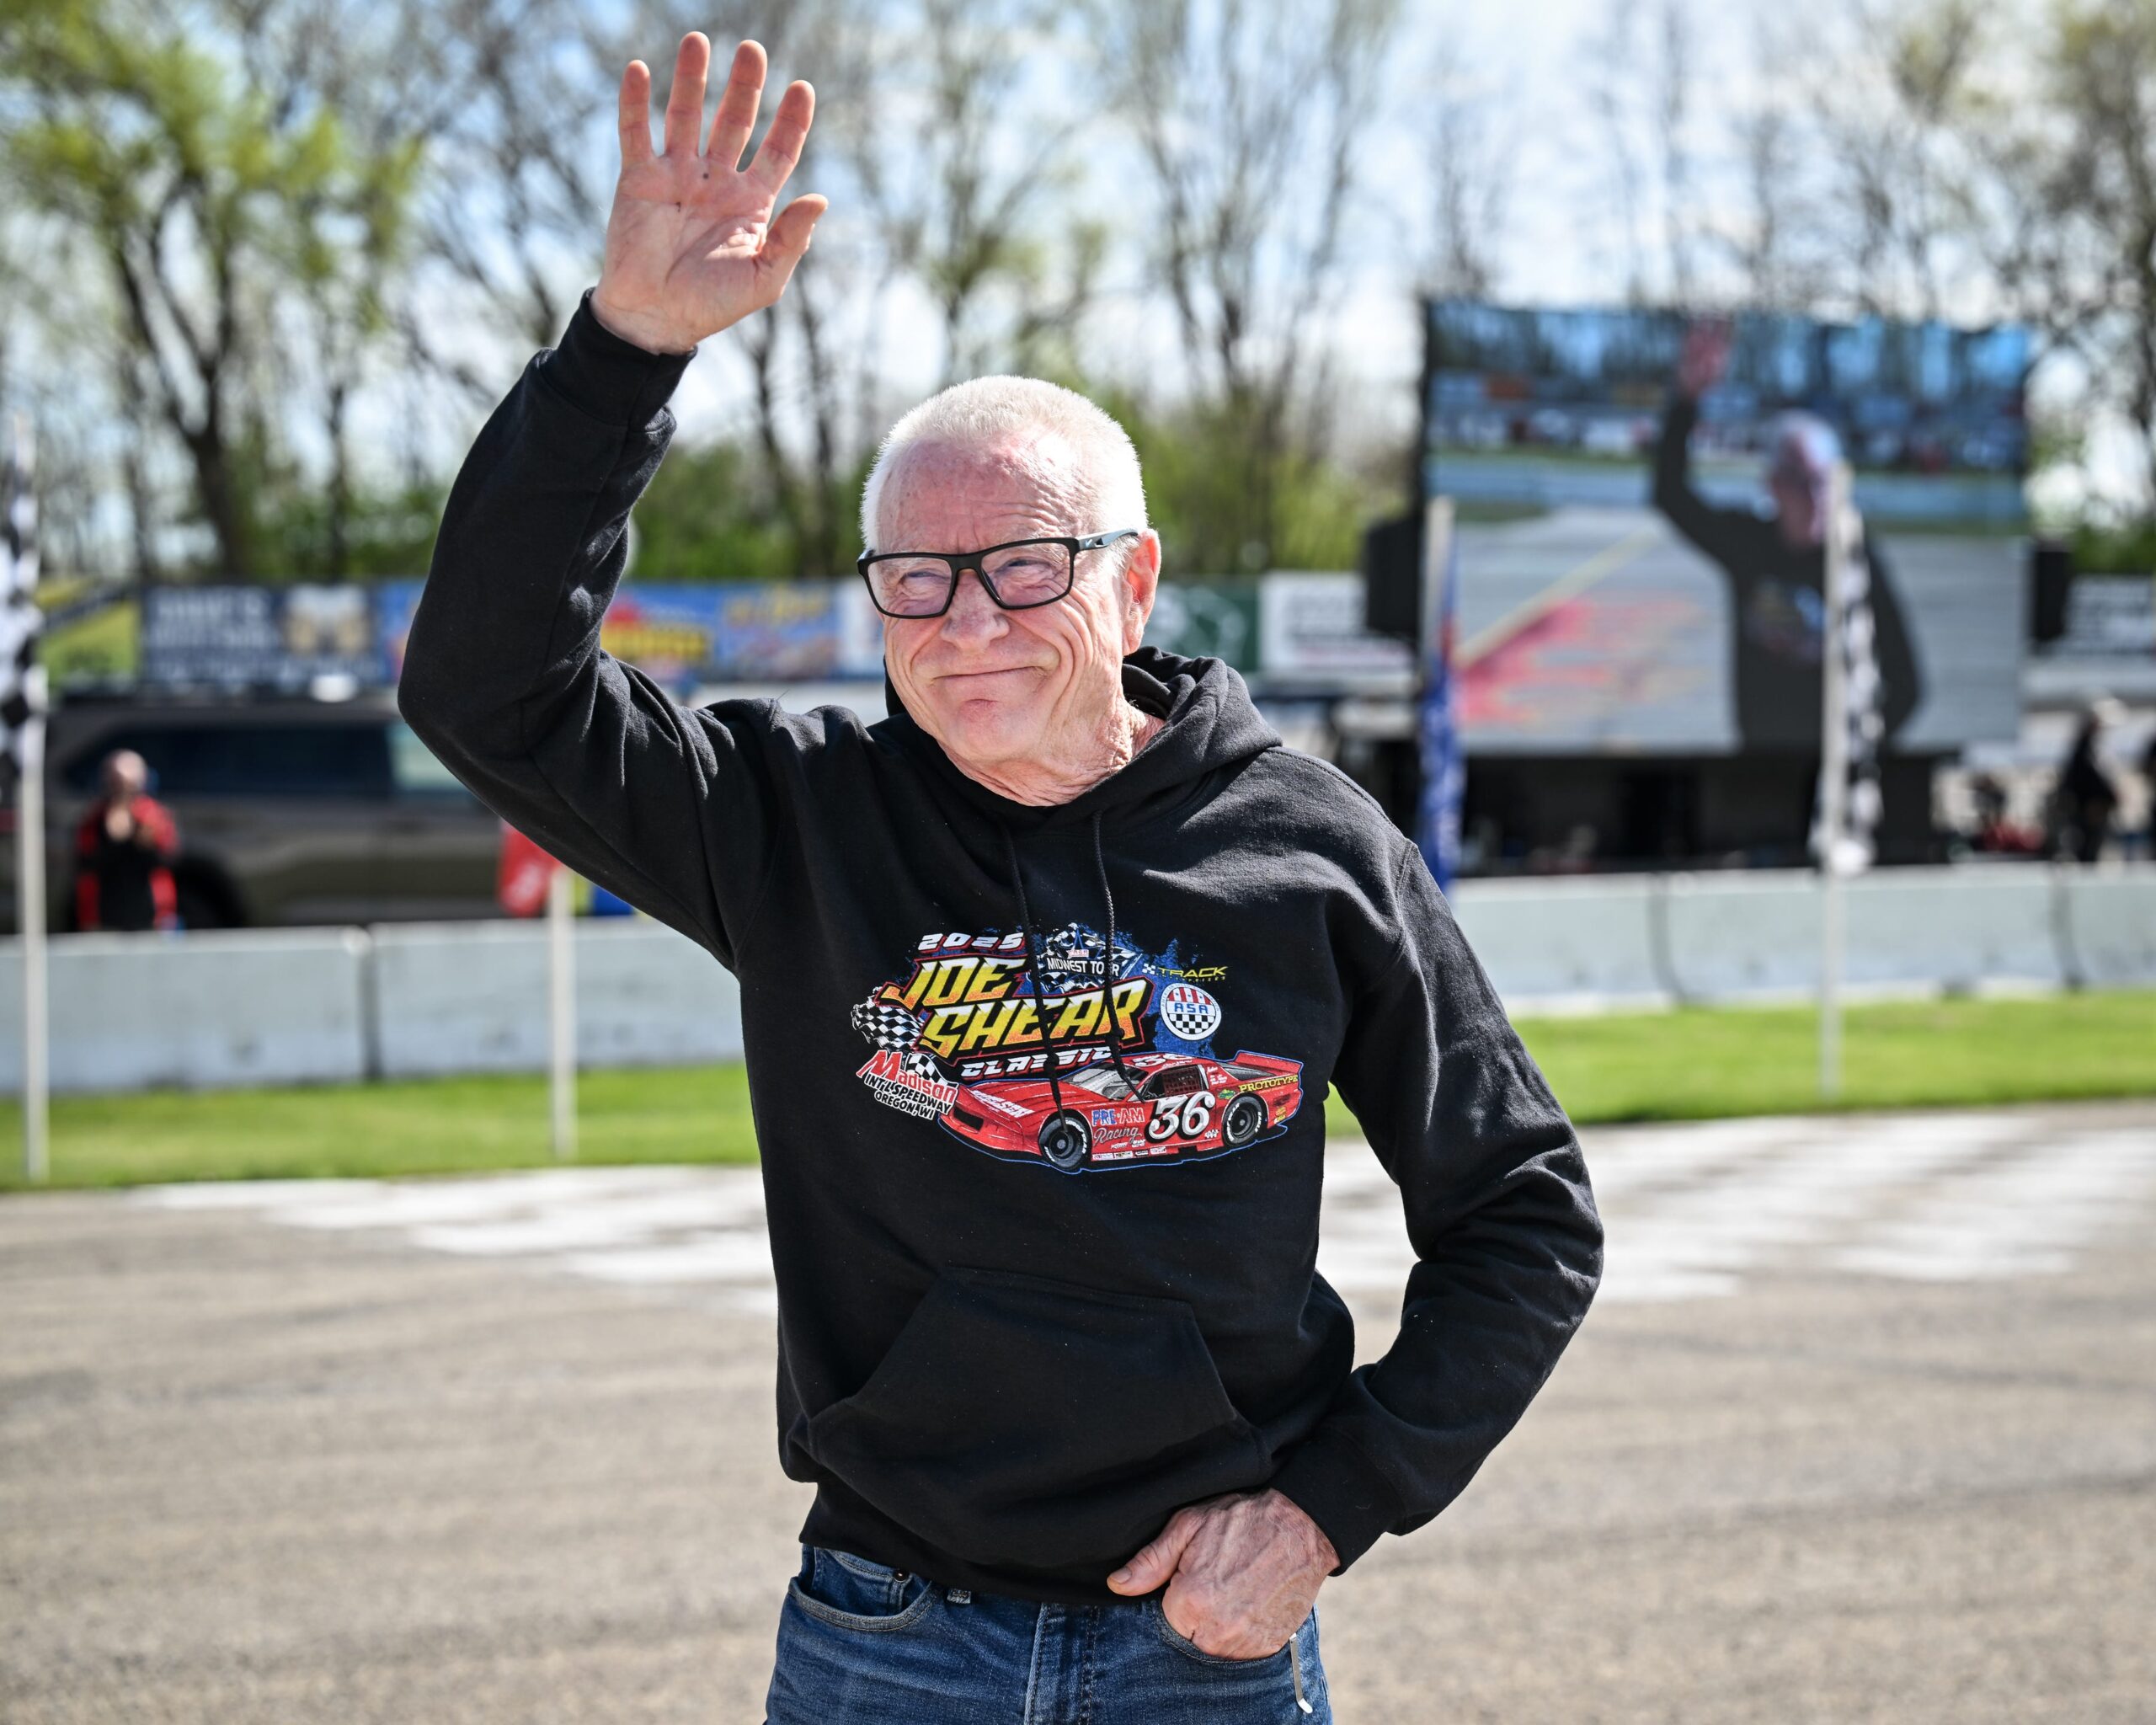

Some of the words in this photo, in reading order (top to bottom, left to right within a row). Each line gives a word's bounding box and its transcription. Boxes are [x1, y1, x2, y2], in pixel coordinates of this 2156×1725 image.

[917, 932, 1026, 953] 2025
[1047, 957, 1087, 974] MIDWEST
[1090, 960, 1120, 976] TOR
[1158, 966, 1228, 978] TRACK
[880, 956, 1027, 1011] JOE
[1174, 1002, 1209, 1014] ASA
[920, 979, 1147, 1059] SHEAR
[960, 1046, 1112, 1079] CLASSIC
[857, 1050, 958, 1104] Madison
[1238, 1074, 1298, 1092] PROTOTYPE
[893, 1084, 952, 1114] SPEEDWAY
[919, 1105, 935, 1119] WI
[1148, 1091, 1215, 1140] 36
[1093, 1127, 1142, 1146] Racing
